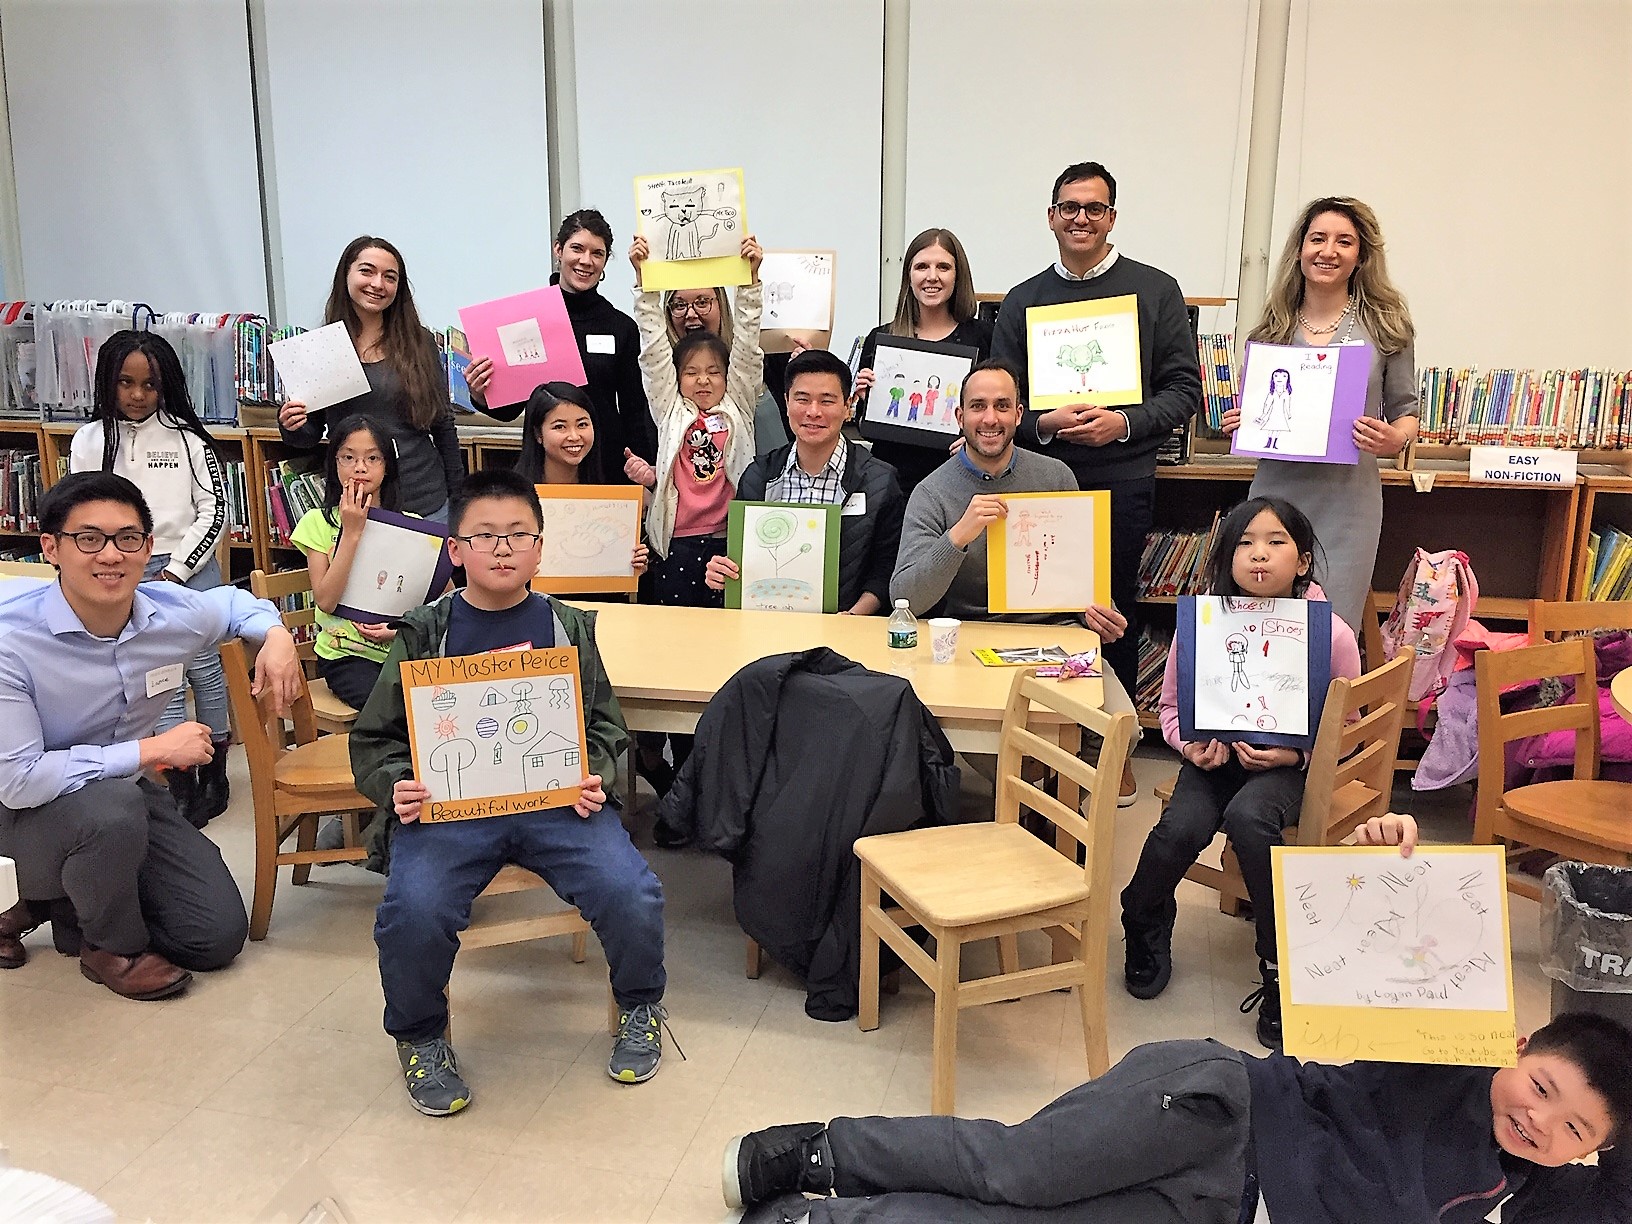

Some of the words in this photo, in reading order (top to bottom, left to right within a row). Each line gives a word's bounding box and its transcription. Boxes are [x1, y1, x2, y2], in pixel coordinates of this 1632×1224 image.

[1301, 363, 1332, 374] Reading
[205, 448, 219, 482] BELIEVE
[1508, 456, 1540, 465] EASY
[1485, 470, 1560, 482] NON-FICTION
[188, 538, 214, 565] HAPPEN
[411, 661, 440, 686] MY
[450, 656, 516, 680] Master
[520, 651, 570, 672] Peice
[431, 800, 508, 820] Beautiful
[1377, 860, 1432, 894] Neat
[1295, 882, 1322, 925] Neat
[1457, 870, 1489, 915] Neat
[1304, 954, 1346, 979] Neat
[1450, 952, 1496, 990] Neat
[1356, 990, 1372, 1004] by
[1374, 990, 1412, 1004] Logan
[1417, 984, 1448, 999] Paul
